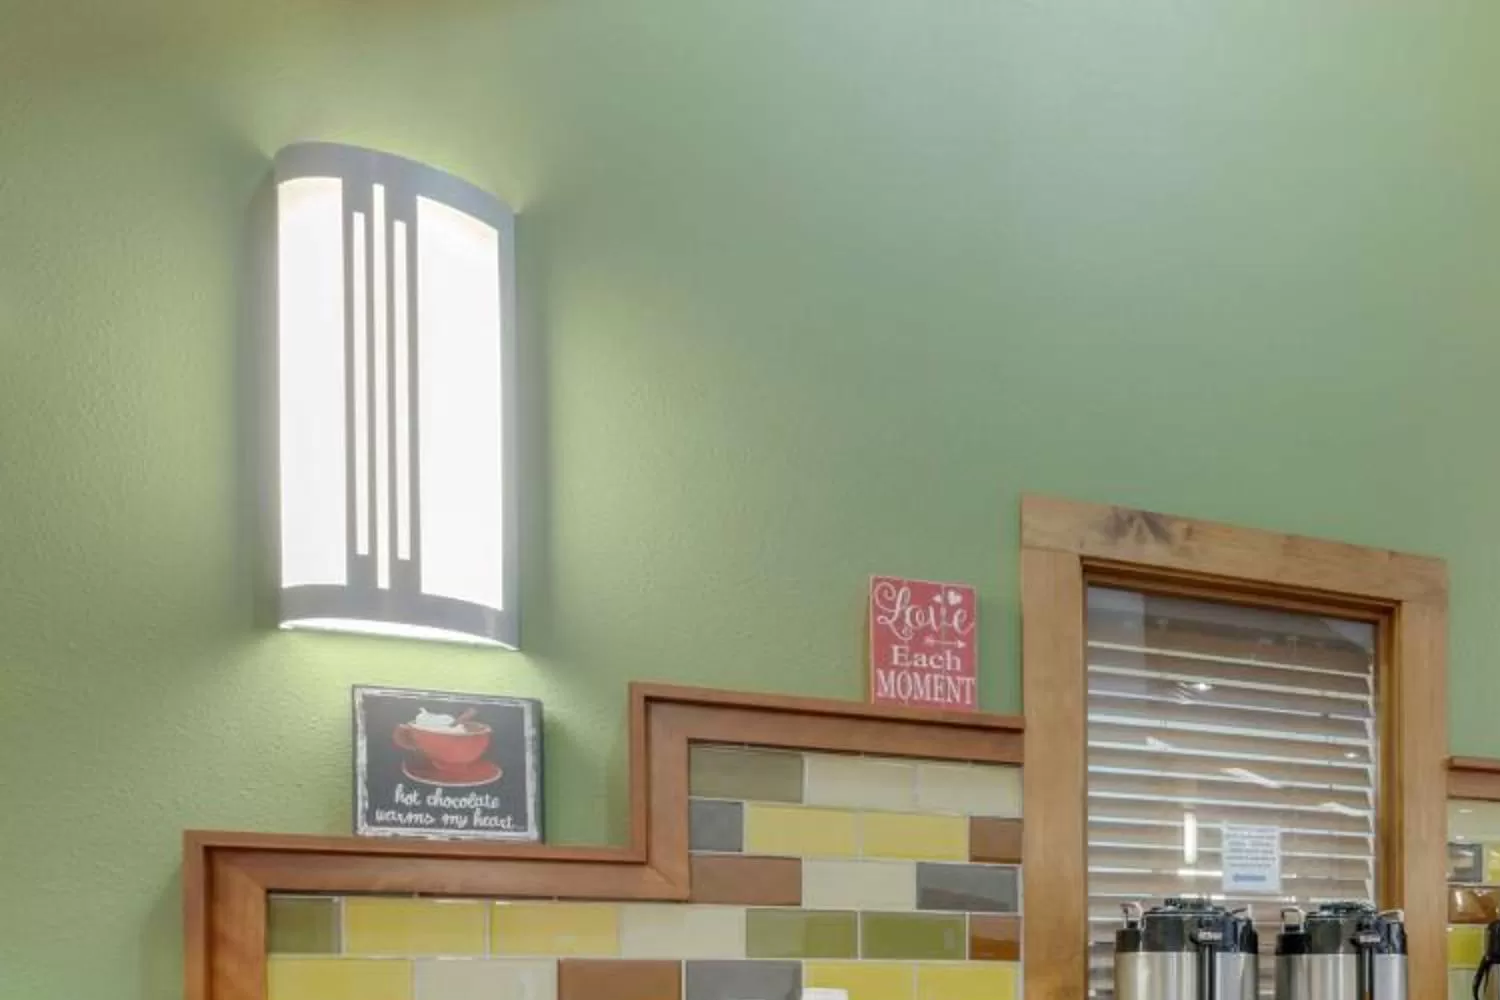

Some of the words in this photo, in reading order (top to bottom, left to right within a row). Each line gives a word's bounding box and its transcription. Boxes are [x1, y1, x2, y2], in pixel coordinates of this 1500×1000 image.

[874, 582, 975, 640] Love
[891, 644, 962, 671] Each
[876, 668, 977, 704] MOMENT
[395, 784, 421, 805] hot
[426, 787, 500, 809] chocolate
[375, 809, 436, 825] warms
[441, 813, 468, 828] my
